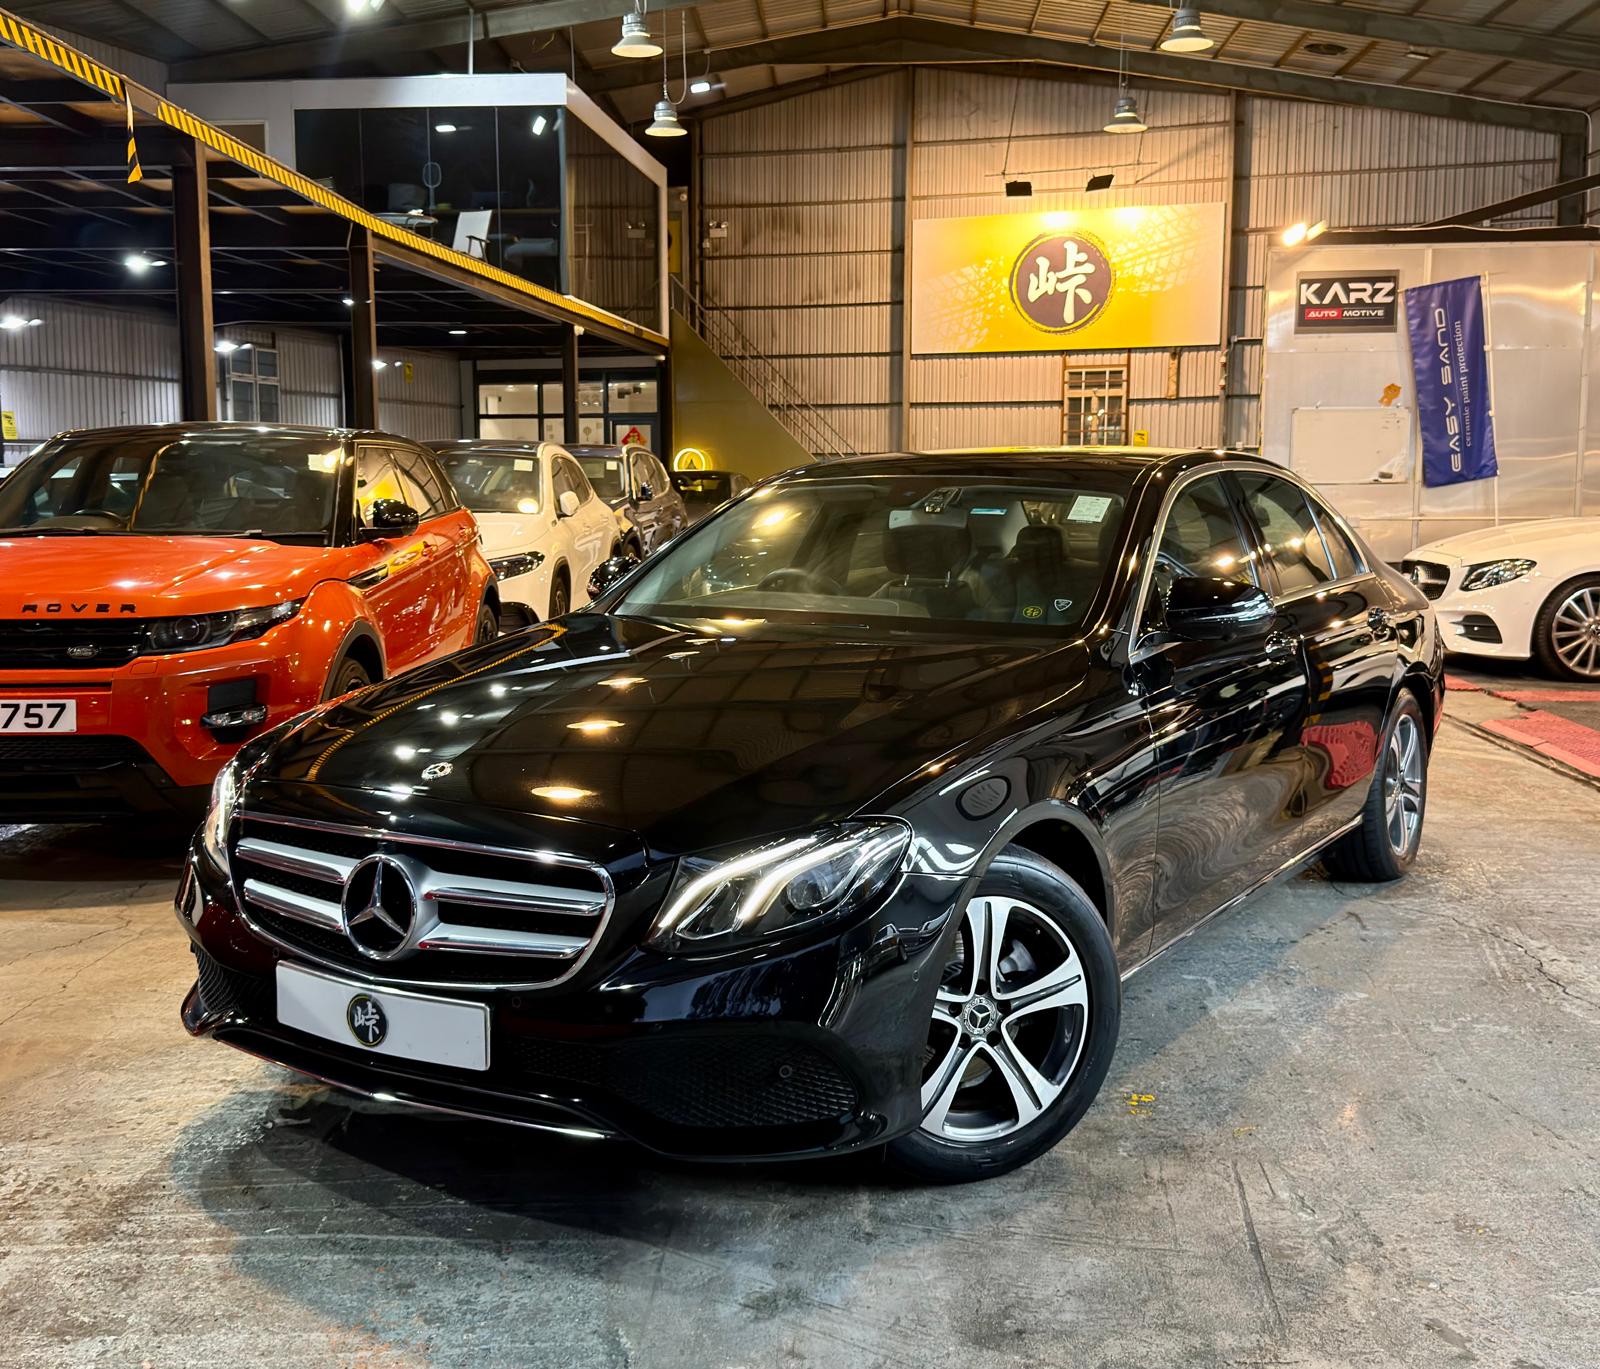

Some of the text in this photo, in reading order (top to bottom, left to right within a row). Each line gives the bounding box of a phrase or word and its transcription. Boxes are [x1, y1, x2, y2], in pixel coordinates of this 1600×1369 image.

[1027, 240, 1096, 324] 峠
[1300, 282, 1394, 305] KARZ
[1308, 309, 1384, 318] AUTO MOTIVE
[1434, 308, 1462, 473] EASY SAND
[1454, 320, 1472, 447] ceramic paint protection
[22, 603, 136, 613] ROVER
[0, 703, 67, 729] 757
[354, 1000, 380, 1042] 峠
